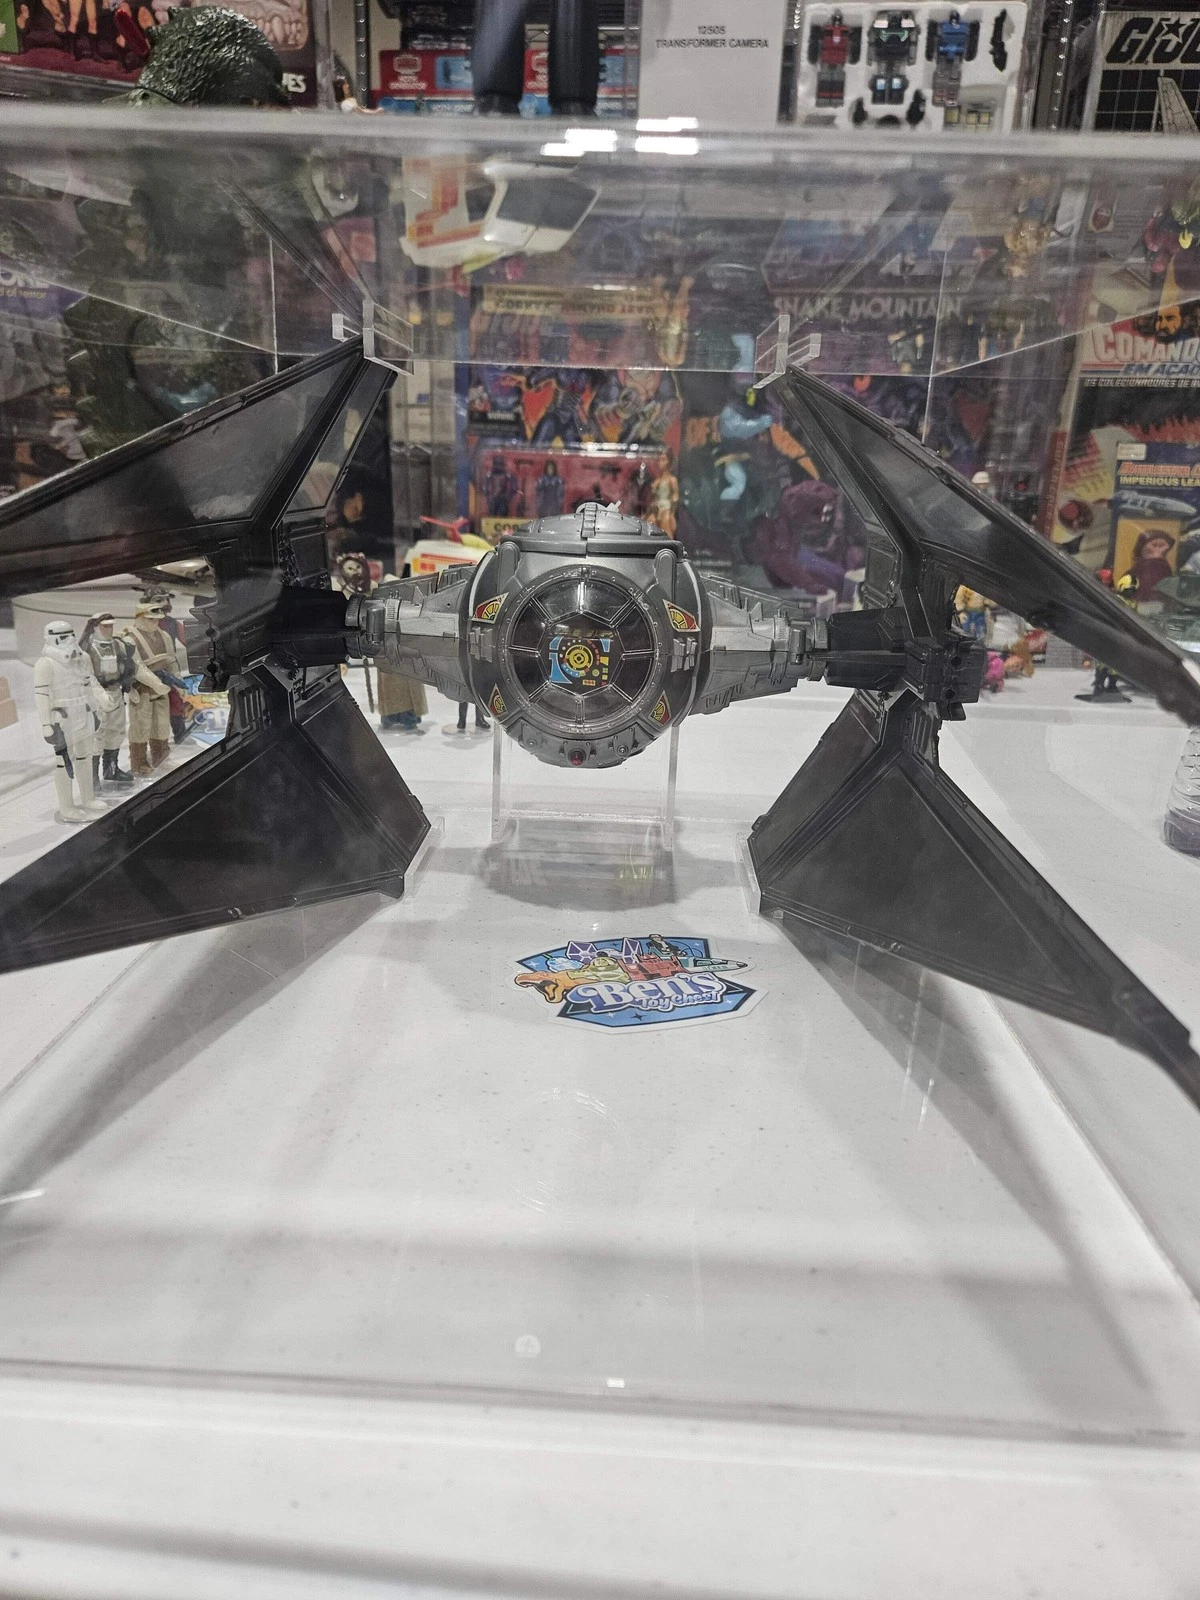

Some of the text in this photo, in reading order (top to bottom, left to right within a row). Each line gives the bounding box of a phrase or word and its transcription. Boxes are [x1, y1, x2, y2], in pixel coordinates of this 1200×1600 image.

[697, 25, 726, 35] 12505
[656, 38, 768, 49] TRANSFORMER CAMERA
[773, 296, 963, 322] SNAKE MOUNTAIN
[1119, 475, 1180, 487] IMPERIOUS
[576, 972, 724, 1007] Ben's
[639, 990, 719, 1009] Toy Chest
